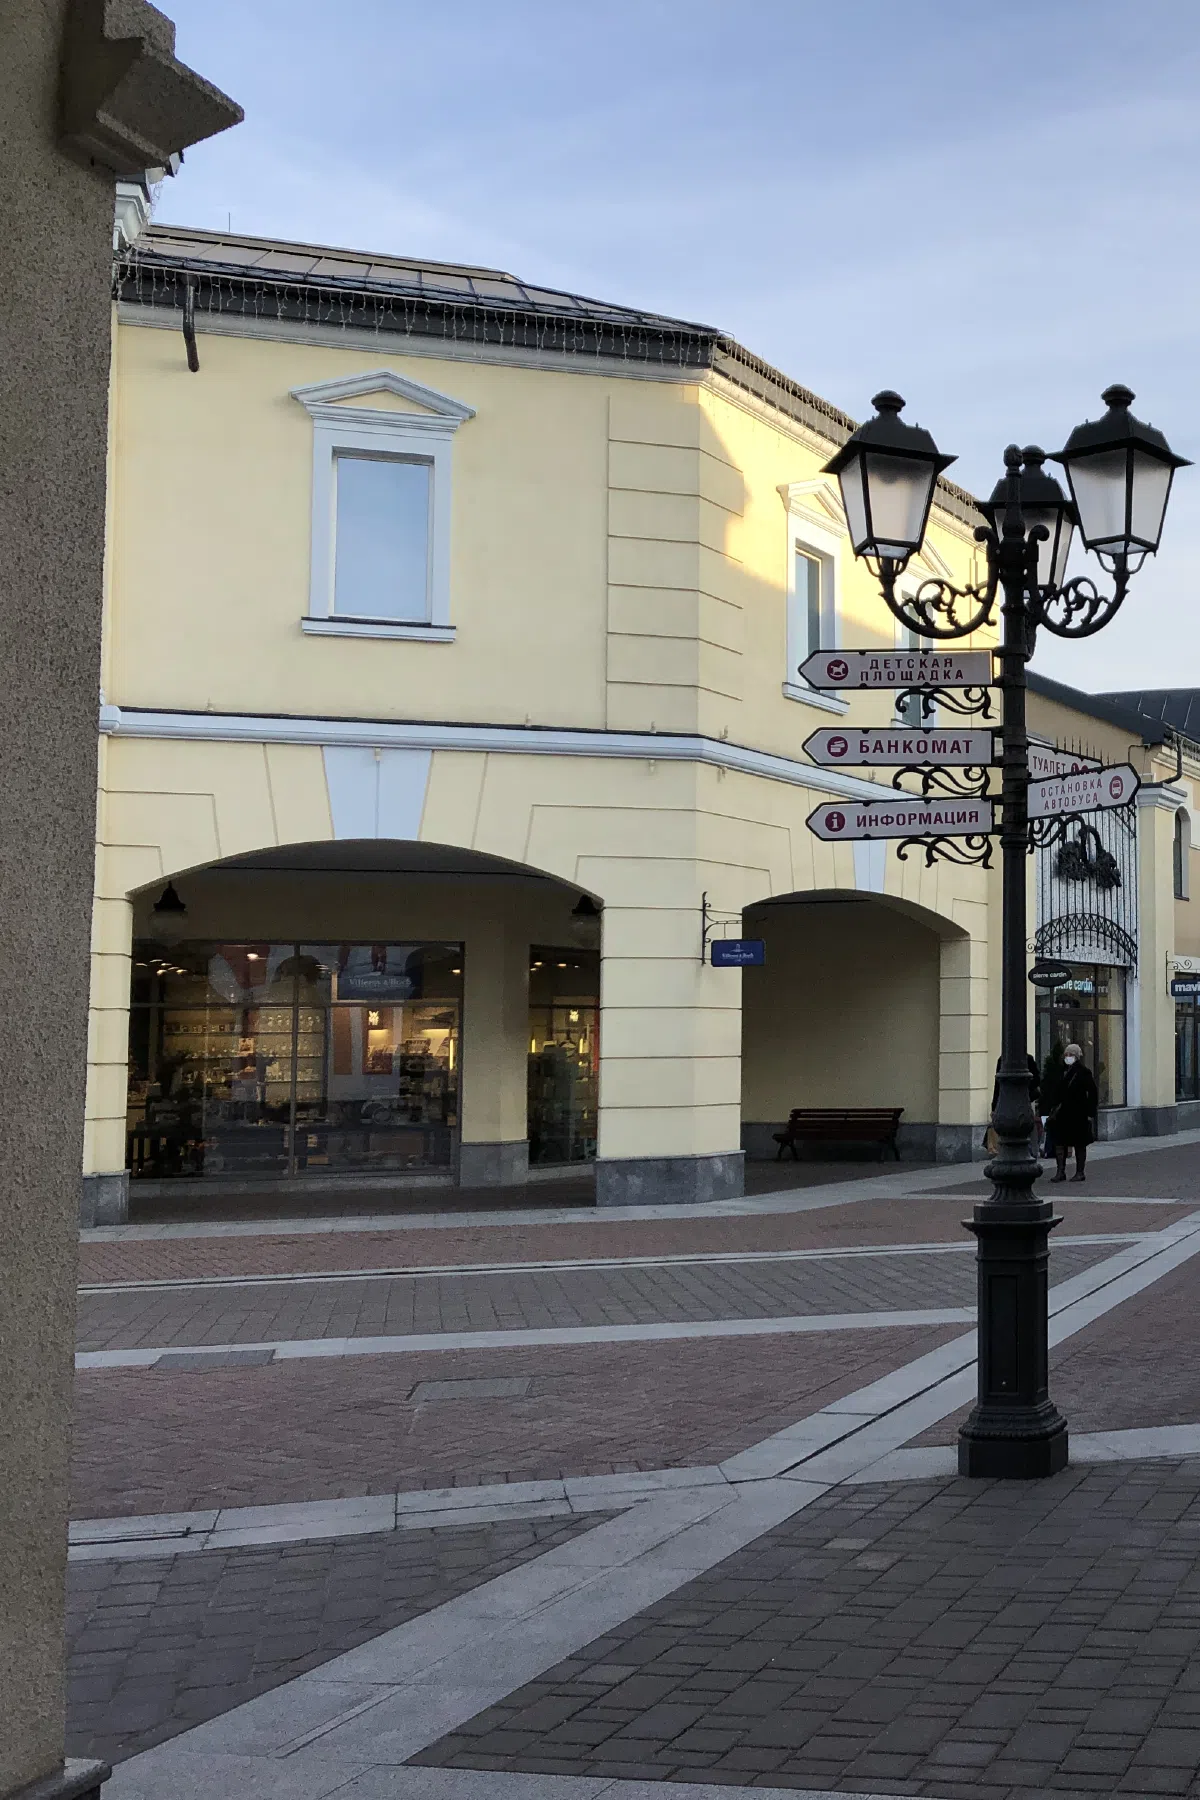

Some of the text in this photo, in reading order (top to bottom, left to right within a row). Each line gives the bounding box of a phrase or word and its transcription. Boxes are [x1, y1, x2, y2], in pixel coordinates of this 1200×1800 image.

[869, 658, 953, 670] ДЕТСКАЯ
[860, 669, 964, 682] ПЛОЩАДКА
[859, 739, 973, 754] БАНКОМАТ
[1032, 755, 1066, 776] ТУАЛЕТ
[1041, 778, 1103, 798] ОСТАНОВКА
[1044, 792, 1099, 811] АВТОБУСА
[856, 810, 980, 828] ИНФОРМАЦИЯ
[1174, 981, 1200, 992] mavi
